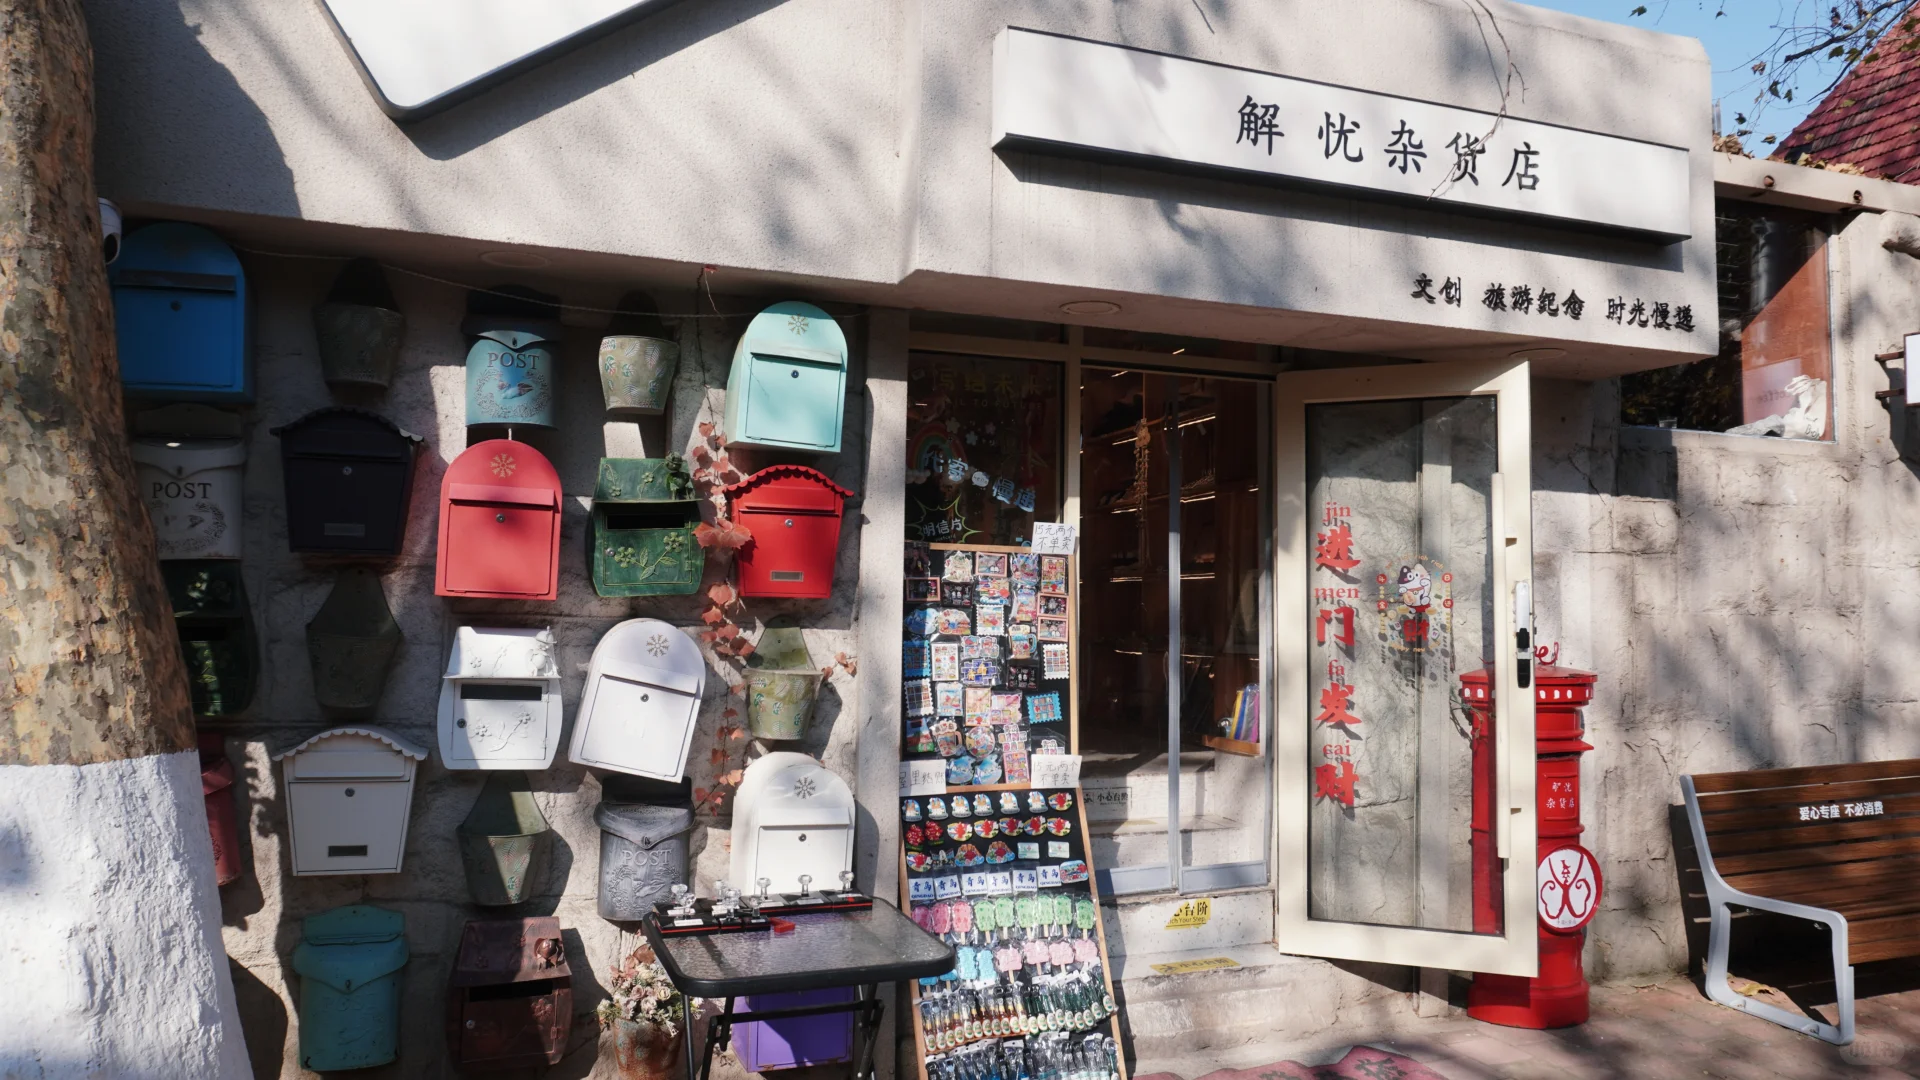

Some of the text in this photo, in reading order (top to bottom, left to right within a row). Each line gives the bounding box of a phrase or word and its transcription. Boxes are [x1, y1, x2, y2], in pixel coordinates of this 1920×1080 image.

[1235, 94, 1541, 192] 解忧杂货店
[1411, 272, 1697, 333] 文创 旅游纪念 时光慢递
[486, 352, 540, 370] POST
[152, 482, 212, 500] POST
[1322, 501, 1351, 522] jin
[923, 517, 962, 537] 明信片
[1034, 524, 1076, 538] 15元两个
[1036, 536, 1072, 553] 不单卖
[1314, 586, 1359, 599] men
[1315, 606, 1355, 647] 门
[1328, 659, 1345, 677] fa
[1314, 682, 1362, 725] 发
[1322, 739, 1351, 756] cai
[1799, 800, 1884, 821] 爱心专座 不必消费
[622, 849, 672, 866] POST
